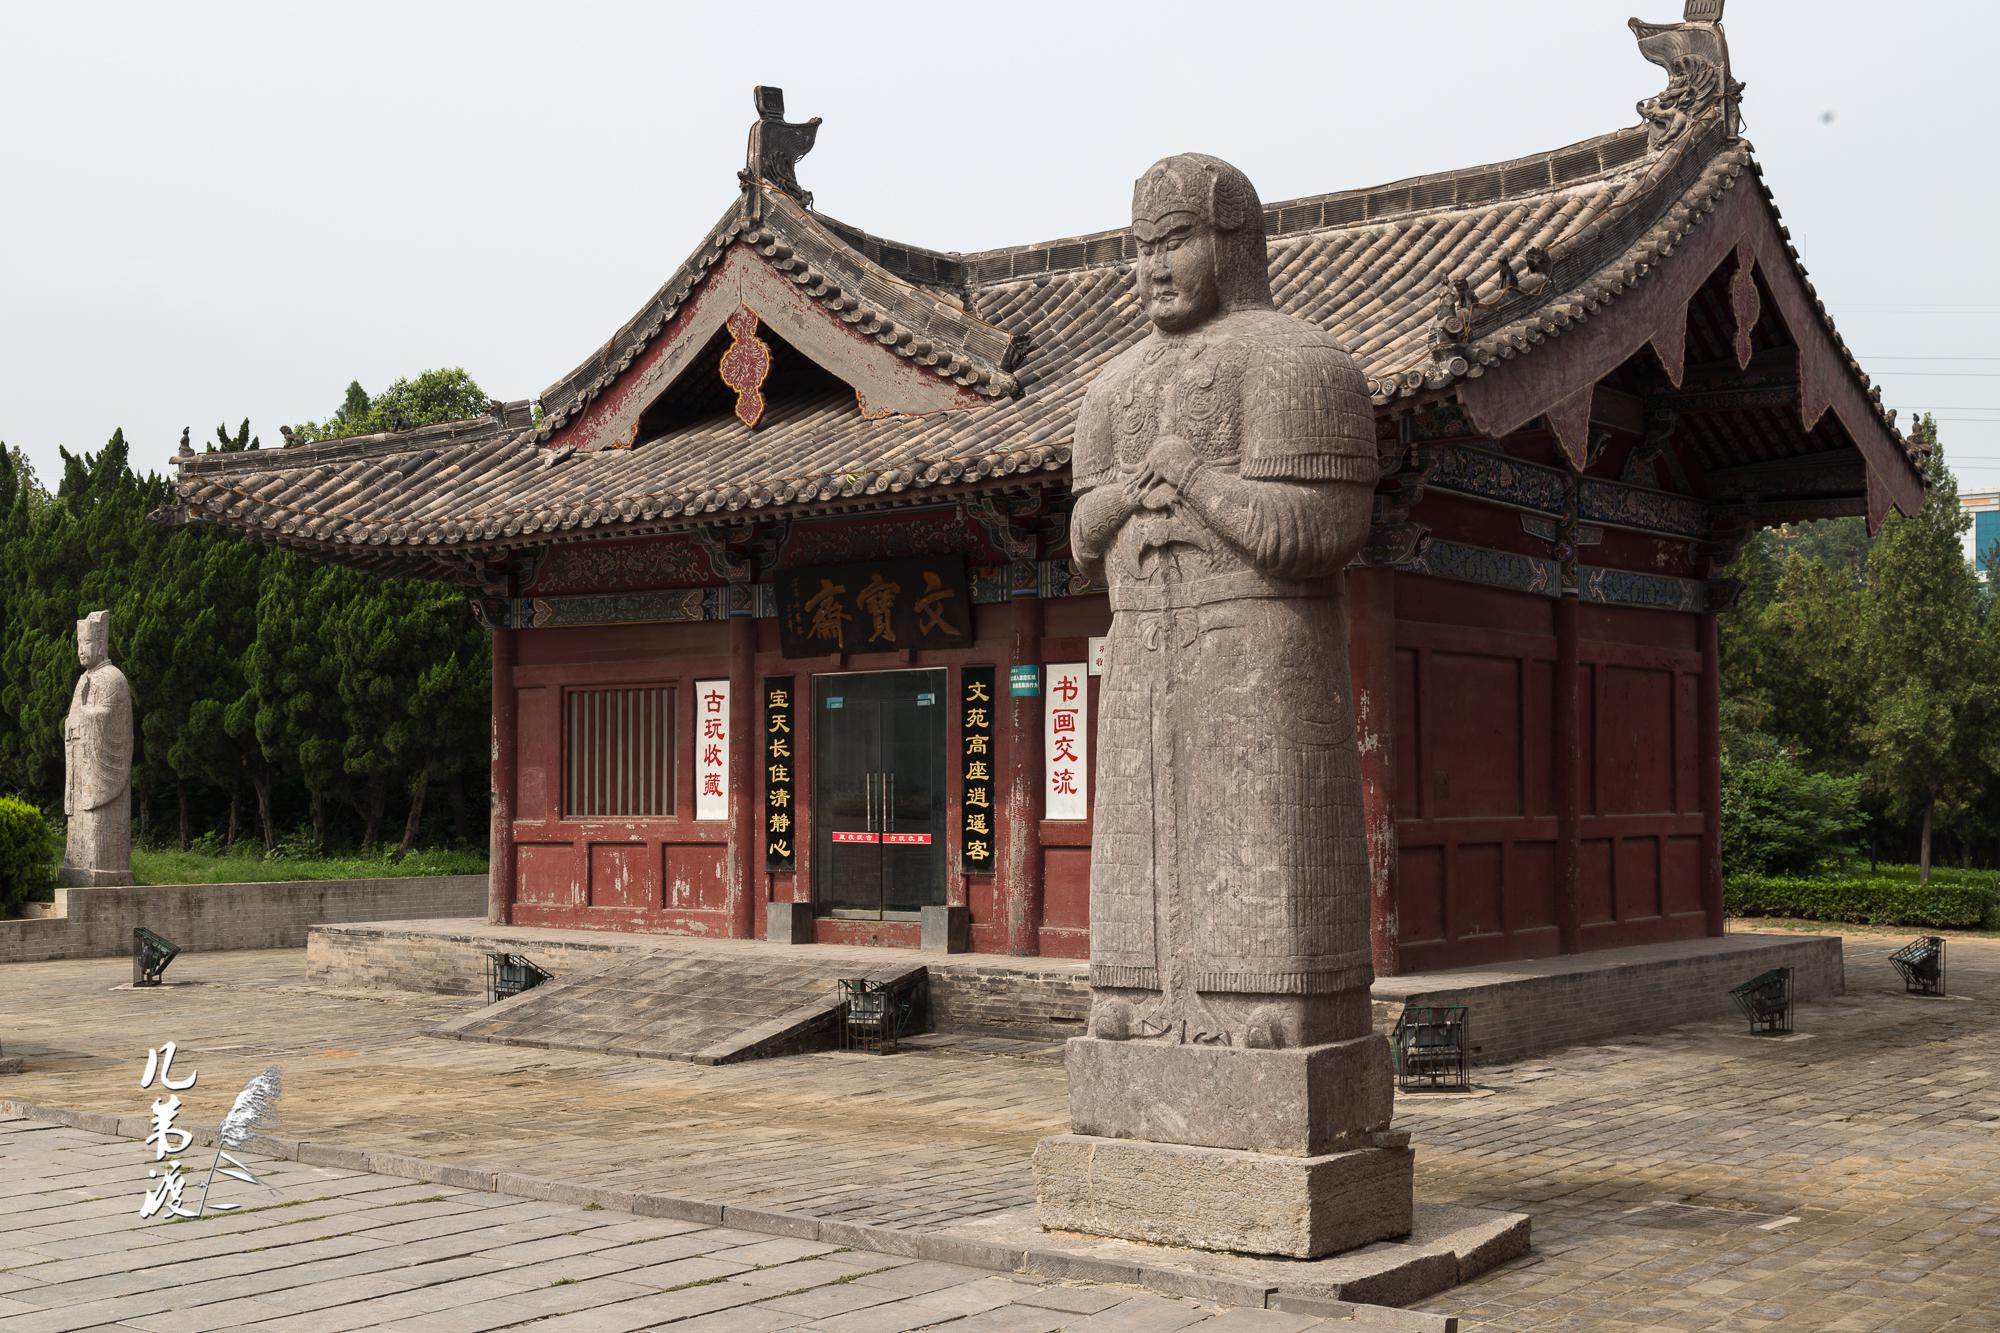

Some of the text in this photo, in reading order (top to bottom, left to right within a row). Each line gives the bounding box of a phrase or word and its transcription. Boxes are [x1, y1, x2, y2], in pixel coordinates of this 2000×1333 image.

[703, 690, 726, 797] 古玩收藏
[769, 690, 791, 857] 宝天长住清静心
[965, 681, 990, 861] 文苑高座逍遥客
[1052, 675, 1079, 795] 书画交流
